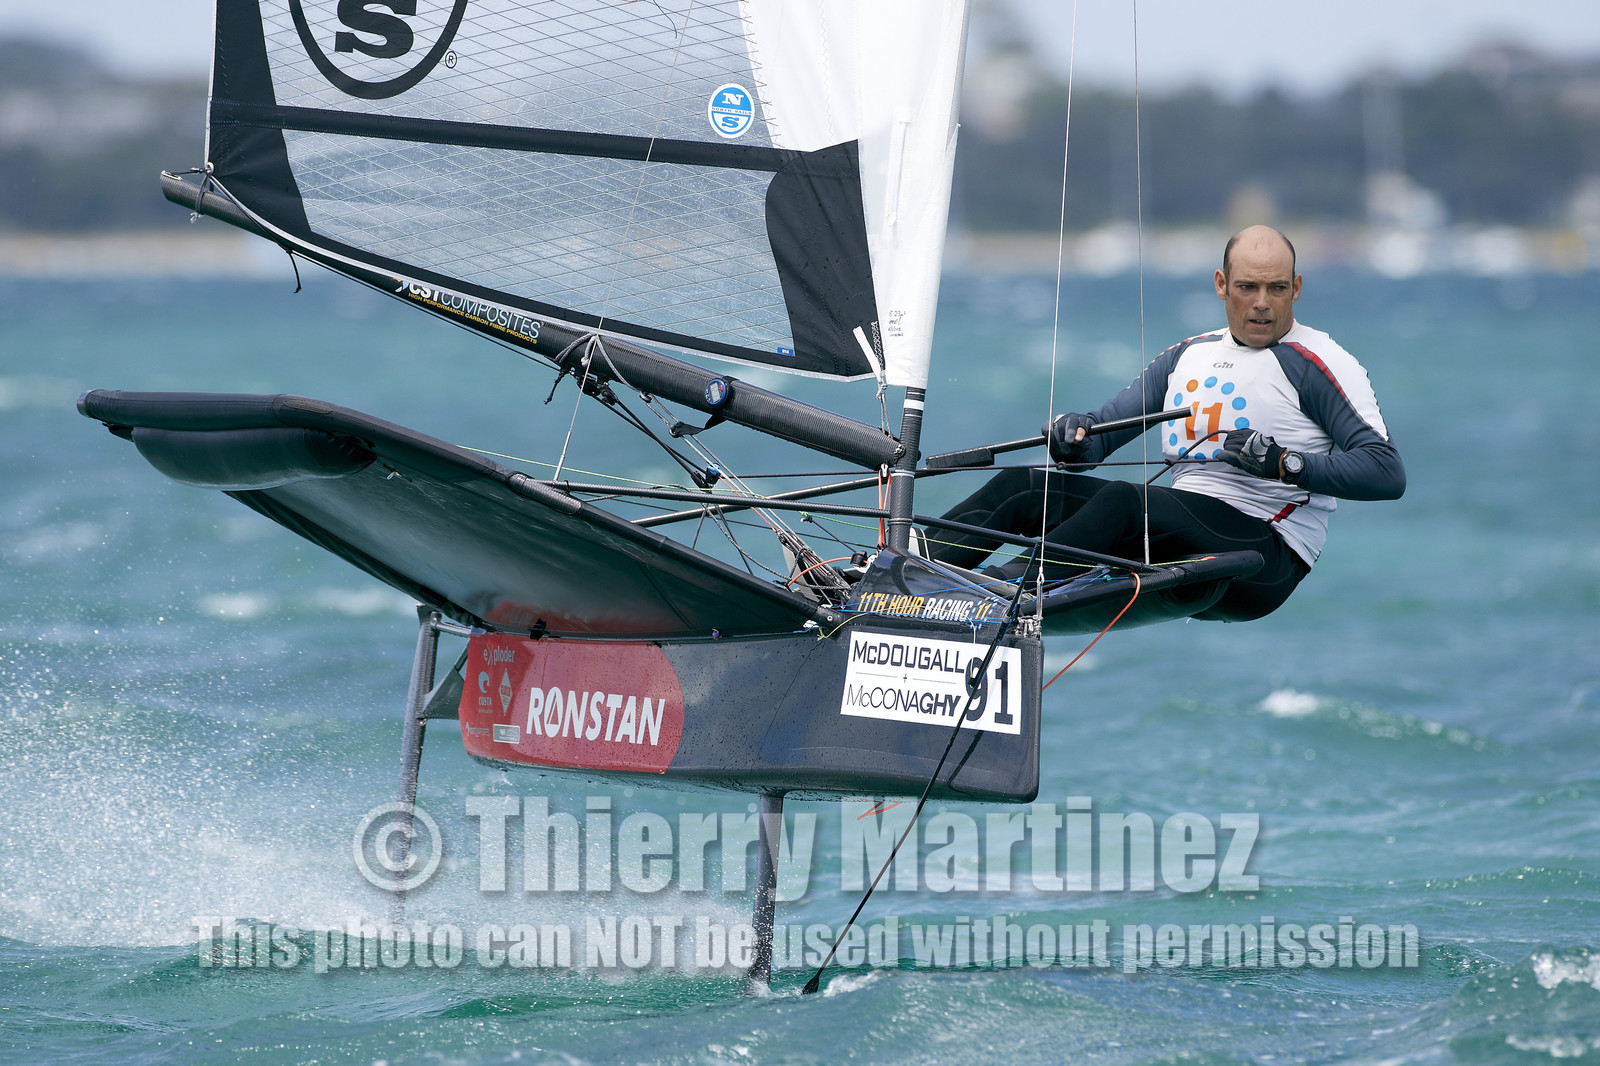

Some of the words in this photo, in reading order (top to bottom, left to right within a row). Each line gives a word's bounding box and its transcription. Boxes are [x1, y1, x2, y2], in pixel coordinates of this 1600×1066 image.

[721, 92, 744, 106] N
[721, 116, 740, 128] S
[408, 292, 423, 303] HIGH
[423, 297, 465, 317] PERFORMANCE
[464, 313, 489, 327] CARBON
[506, 328, 538, 345] PRODUCTS
[1185, 401, 1223, 442] 11
[858, 592, 889, 616] 11TH
[886, 595, 925, 618] HOUR
[922, 597, 974, 622] RACING
[852, 640, 965, 674] McDOUGALL
[846, 683, 961, 717] McCONAGHY
[965, 656, 1013, 726] 91
[526, 686, 666, 746] RONSTAN
